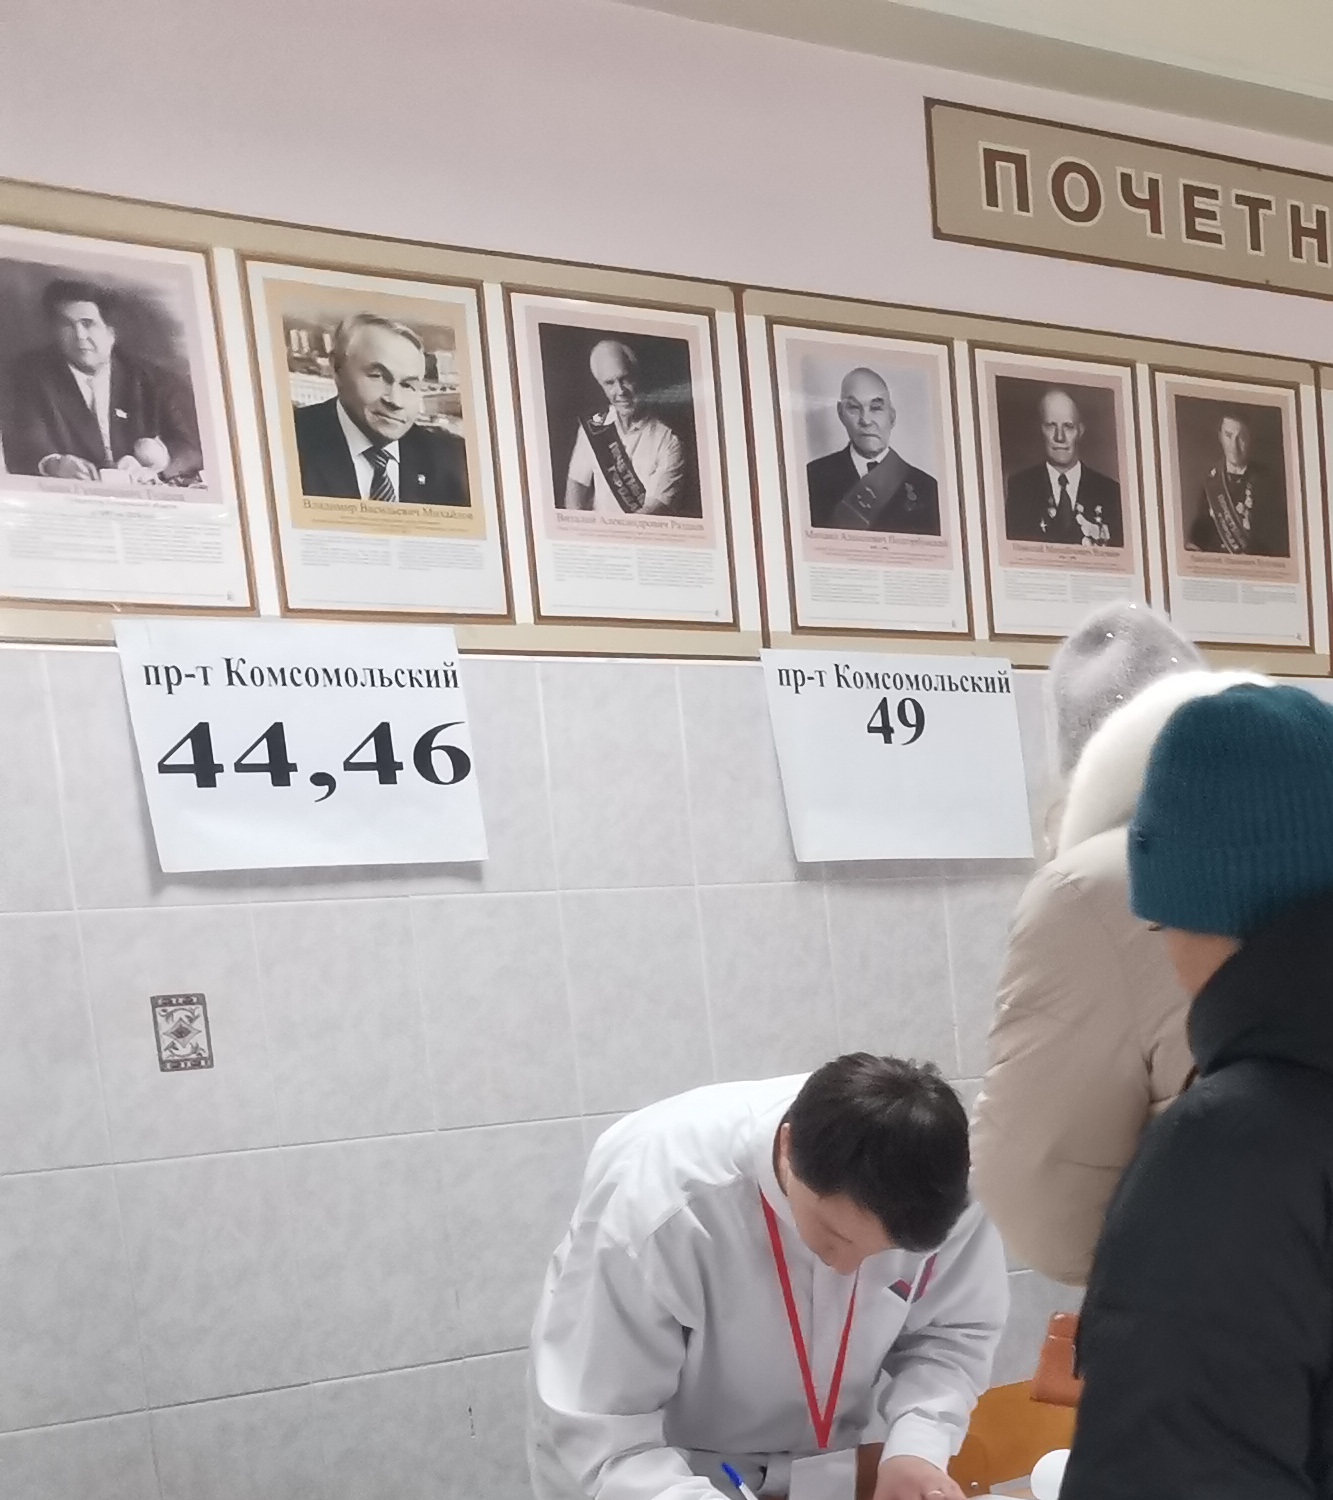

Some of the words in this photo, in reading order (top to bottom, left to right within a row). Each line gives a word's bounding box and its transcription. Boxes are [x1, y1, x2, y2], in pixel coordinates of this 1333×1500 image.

[143, 663, 214, 695] пр-т
[221, 657, 460, 688] Комсомольский
[777, 667, 827, 694] пр-т
[833, 663, 1012, 694] Комсомольский
[866, 696, 926, 746] 49
[157, 721, 472, 803] 44,46
